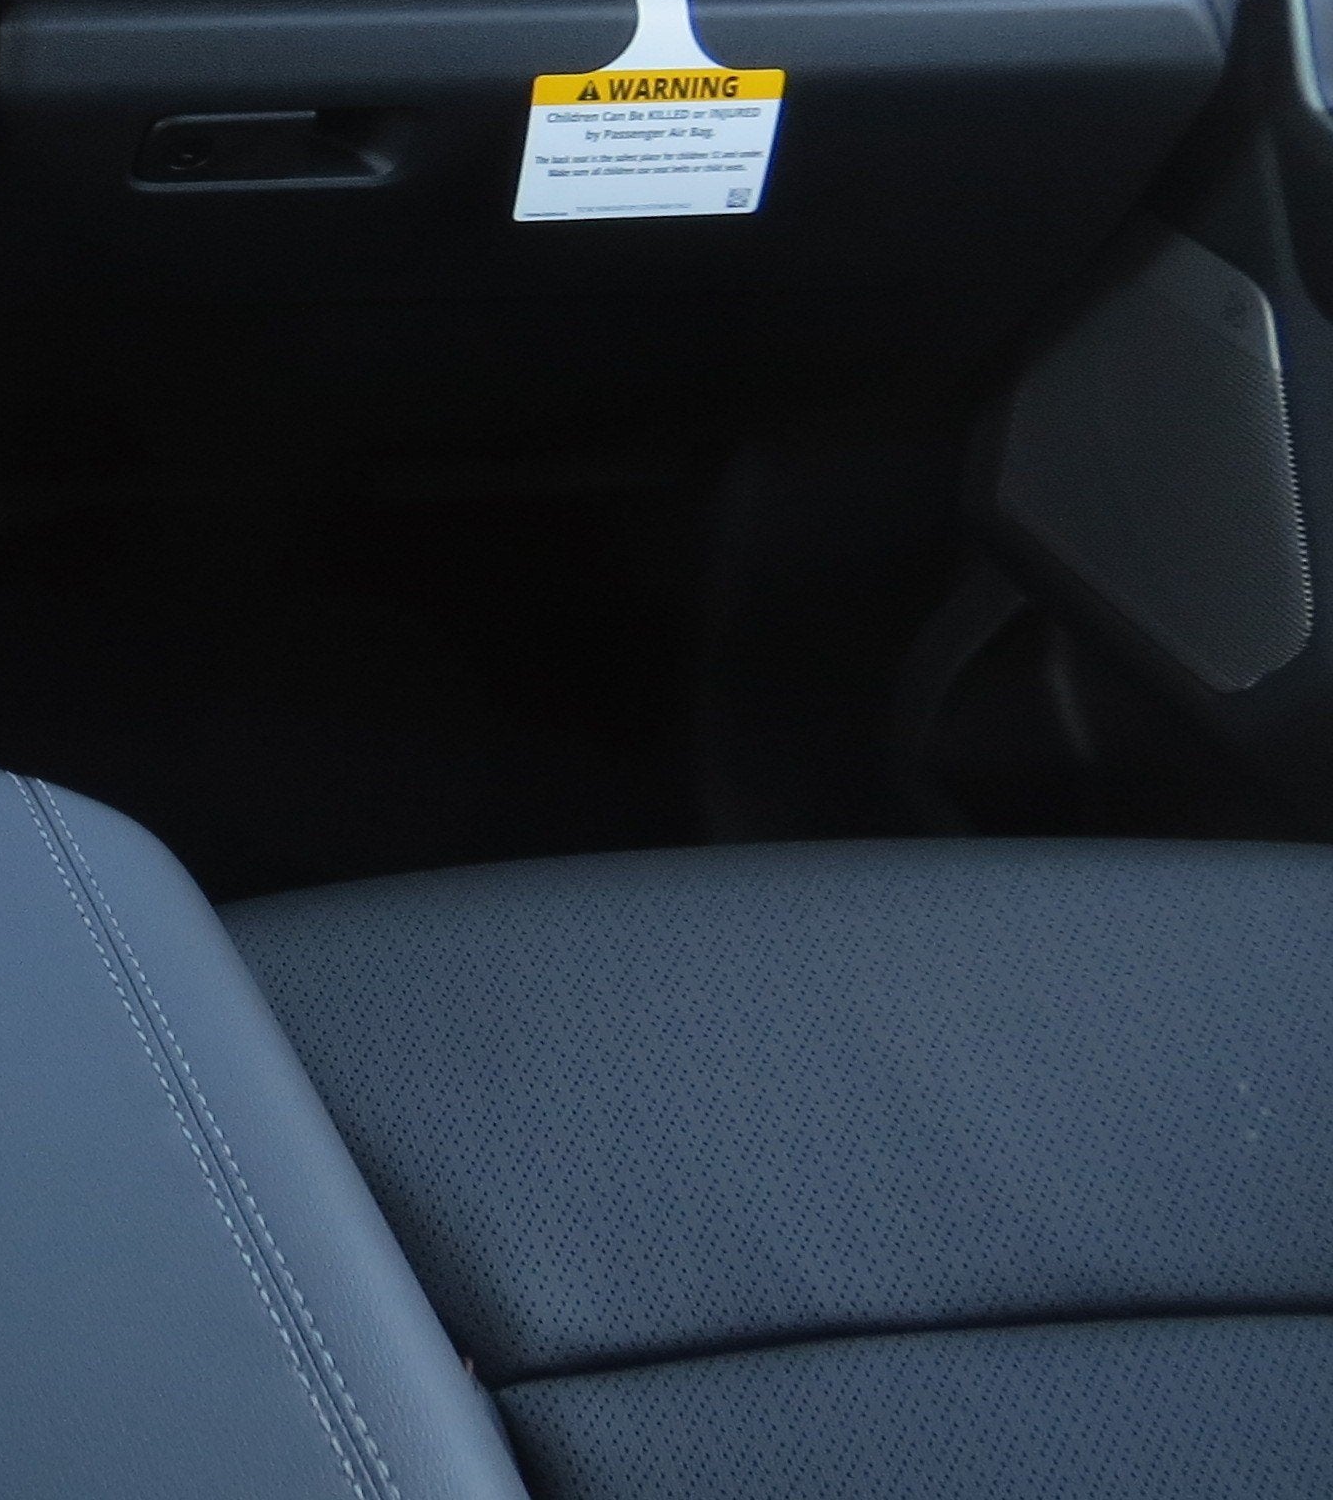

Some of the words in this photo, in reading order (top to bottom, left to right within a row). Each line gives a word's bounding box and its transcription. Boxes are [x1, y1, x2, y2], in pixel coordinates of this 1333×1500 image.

[608, 76, 740, 101] WARNING
[547, 110, 599, 123] Children
[602, 110, 627, 122] Can
[647, 108, 690, 120] KILLED
[584, 129, 601, 143] by
[603, 128, 667, 142] Passenger
[669, 127, 688, 138] Air
